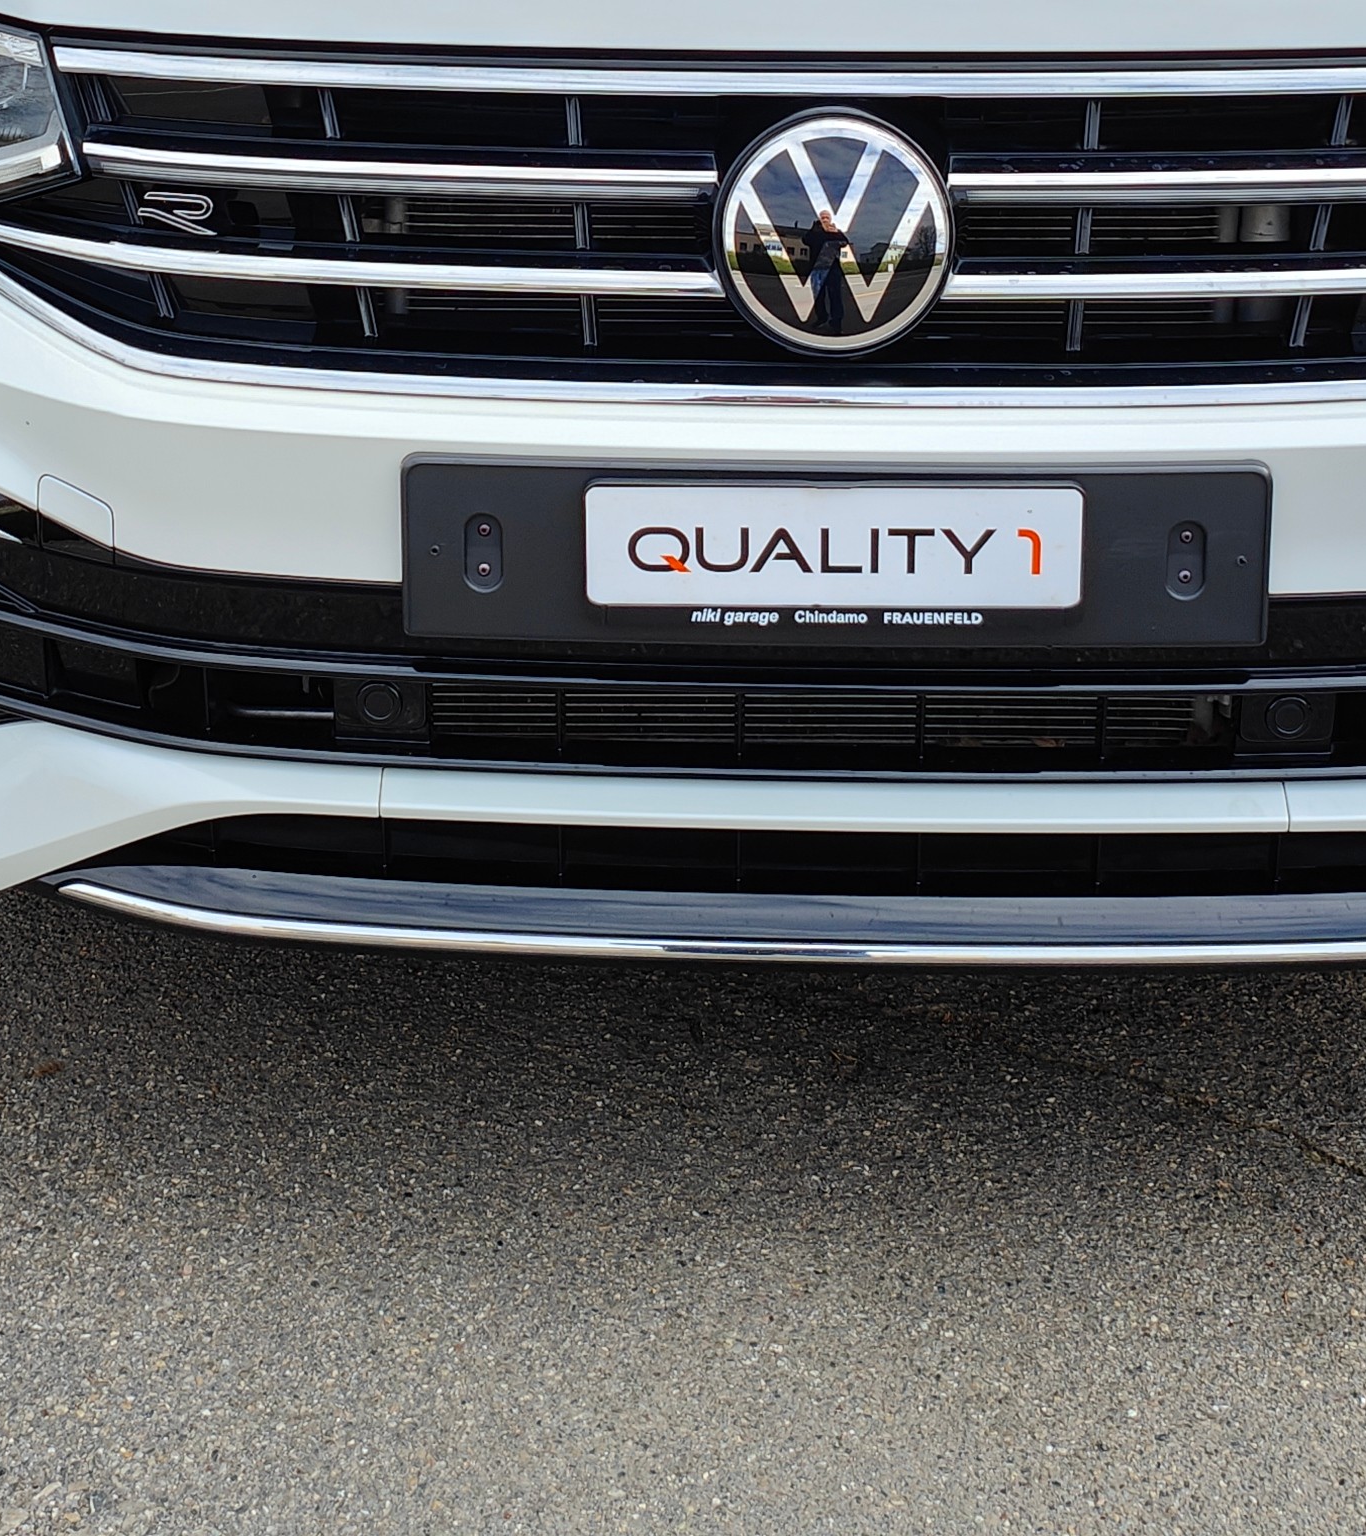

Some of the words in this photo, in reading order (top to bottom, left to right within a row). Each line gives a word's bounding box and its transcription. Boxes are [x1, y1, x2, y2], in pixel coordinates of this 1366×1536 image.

[628, 527, 996, 575] QUALITY
[1018, 528, 1042, 575] 1
[691, 608, 721, 622] niki
[724, 611, 779, 626] garage
[794, 610, 868, 624] Chindamo
[883, 612, 983, 625] FRAUENFELD
